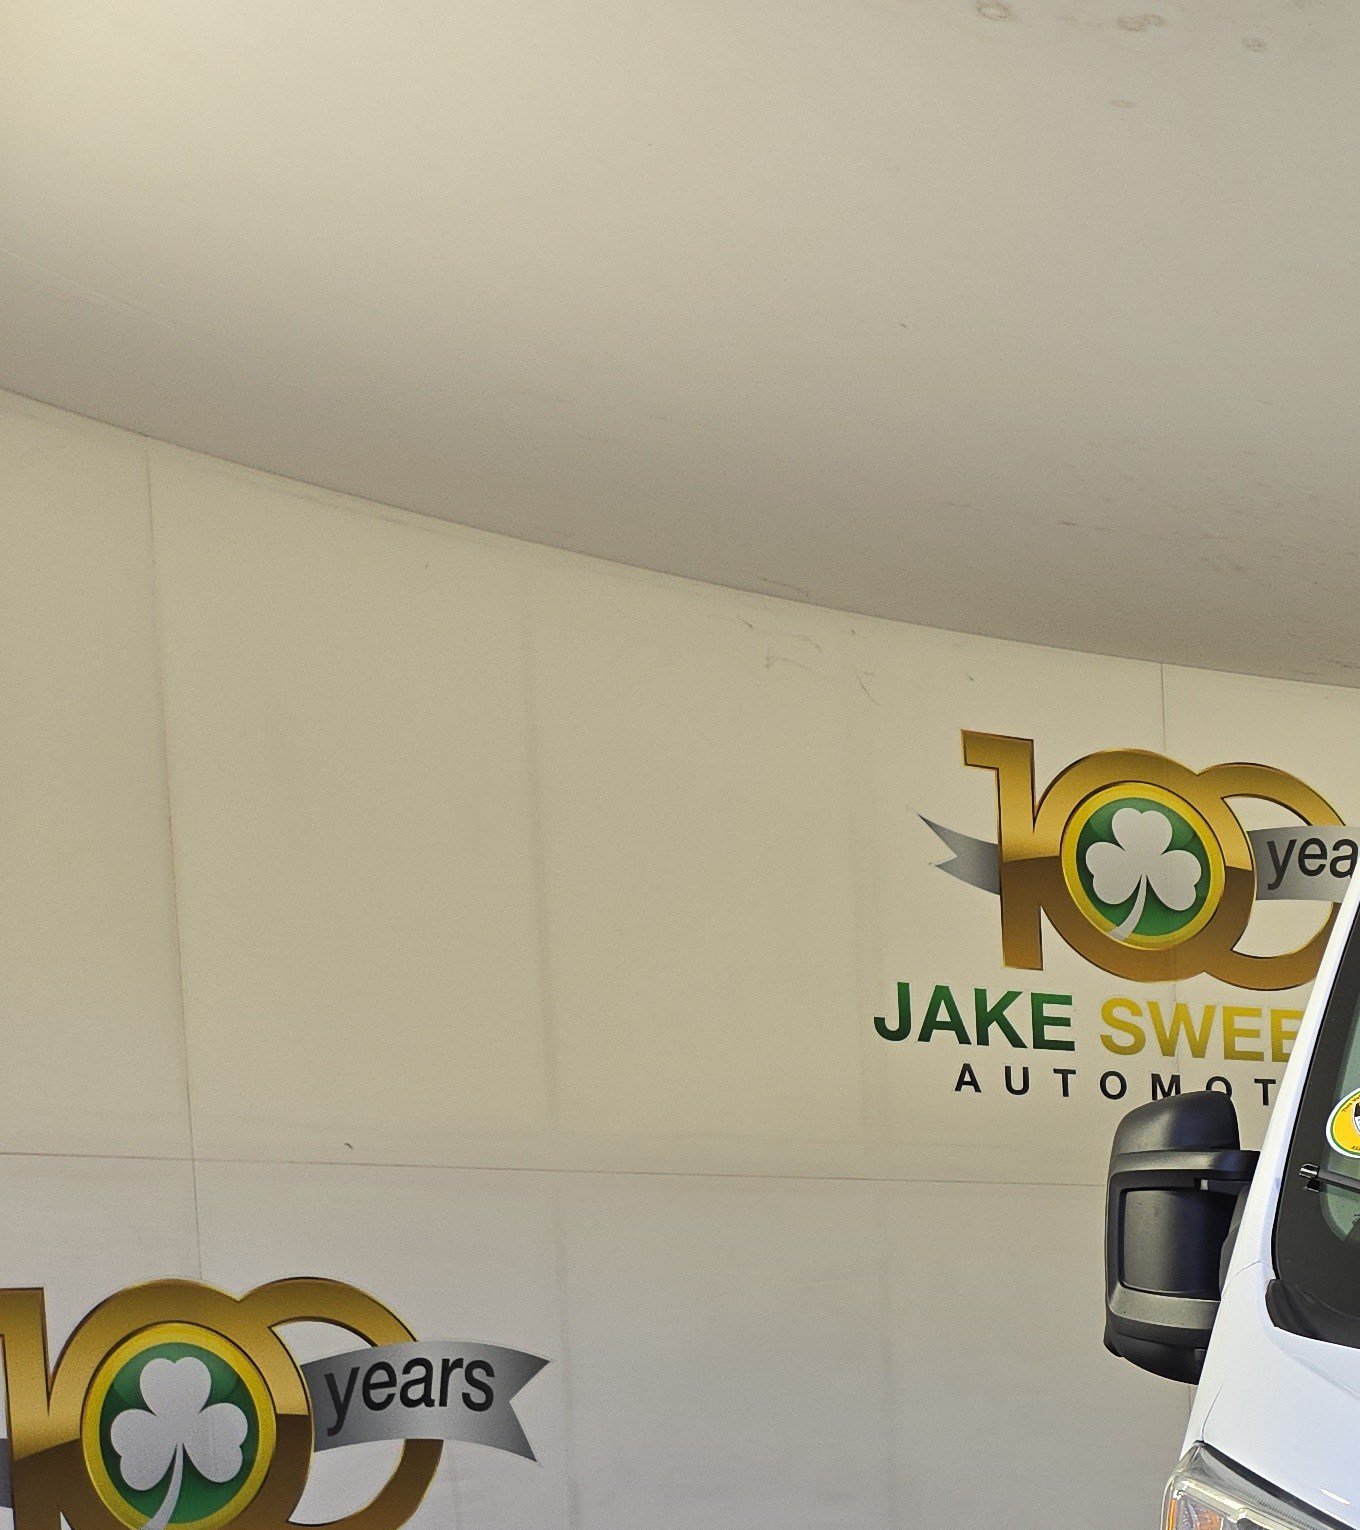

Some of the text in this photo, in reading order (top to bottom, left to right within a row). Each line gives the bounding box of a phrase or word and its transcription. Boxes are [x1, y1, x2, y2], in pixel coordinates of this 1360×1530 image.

[1266, 836, 1358, 890] yea
[874, 982, 1304, 1063] JAKE SWEE
[954, 1063, 1277, 1107] AUTOMOT
[324, 1356, 496, 1436] years
